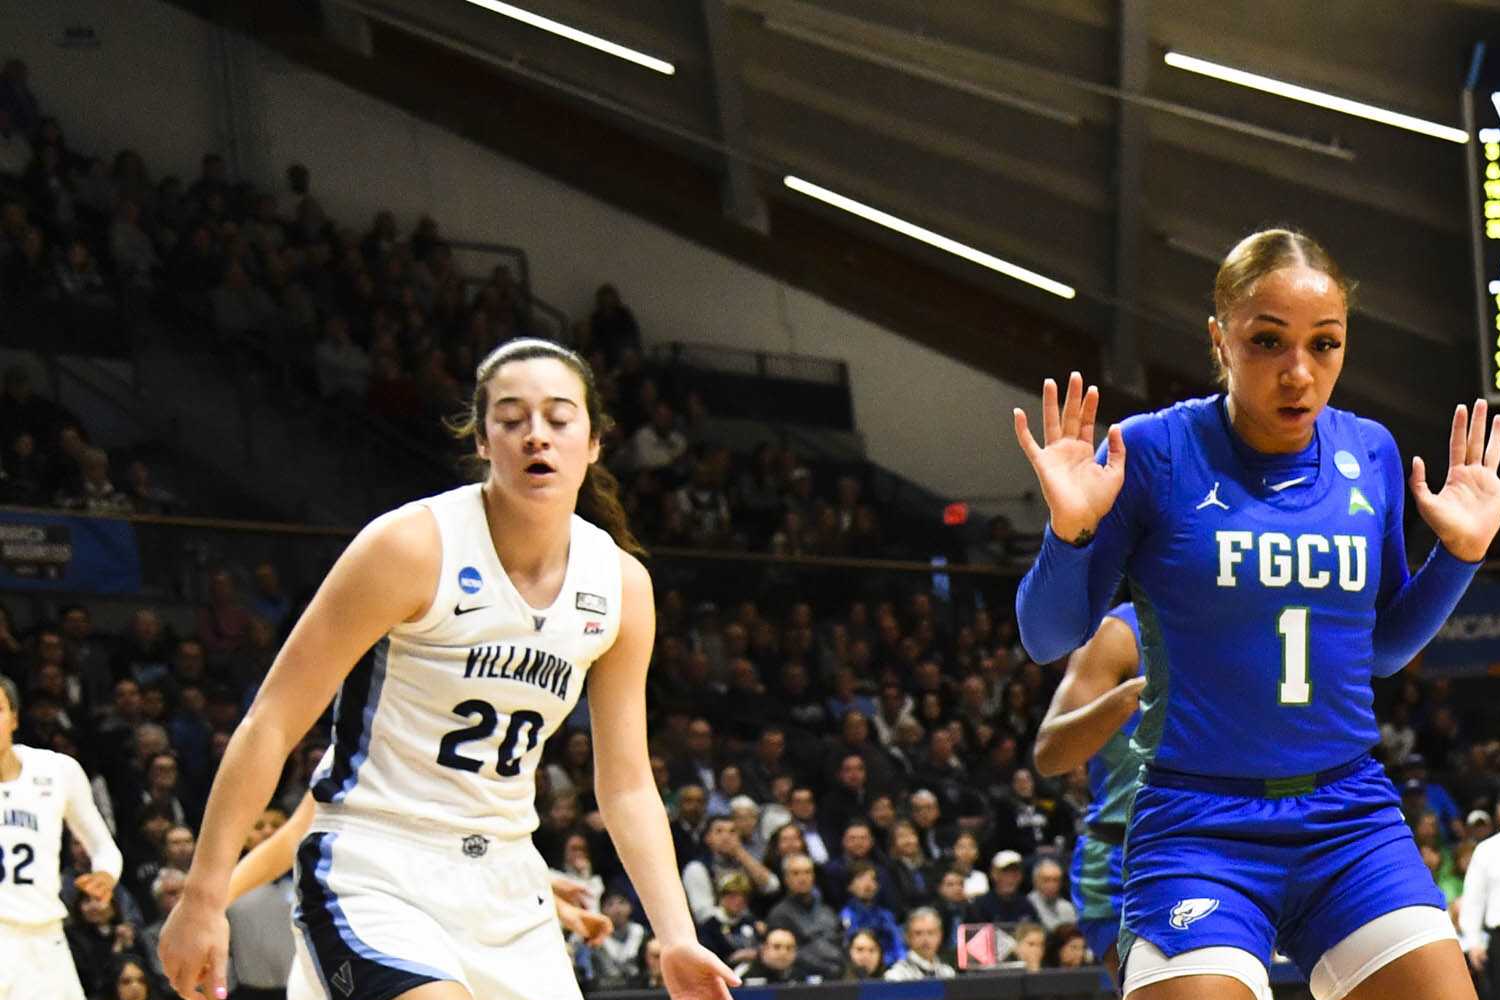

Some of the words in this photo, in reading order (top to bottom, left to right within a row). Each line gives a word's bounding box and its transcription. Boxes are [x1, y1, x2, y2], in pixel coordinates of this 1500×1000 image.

[1215, 530, 1368, 592] FGCU
[464, 645, 573, 701] VILLANOVA
[1278, 607, 1311, 704] 1
[436, 699, 544, 777] 20
